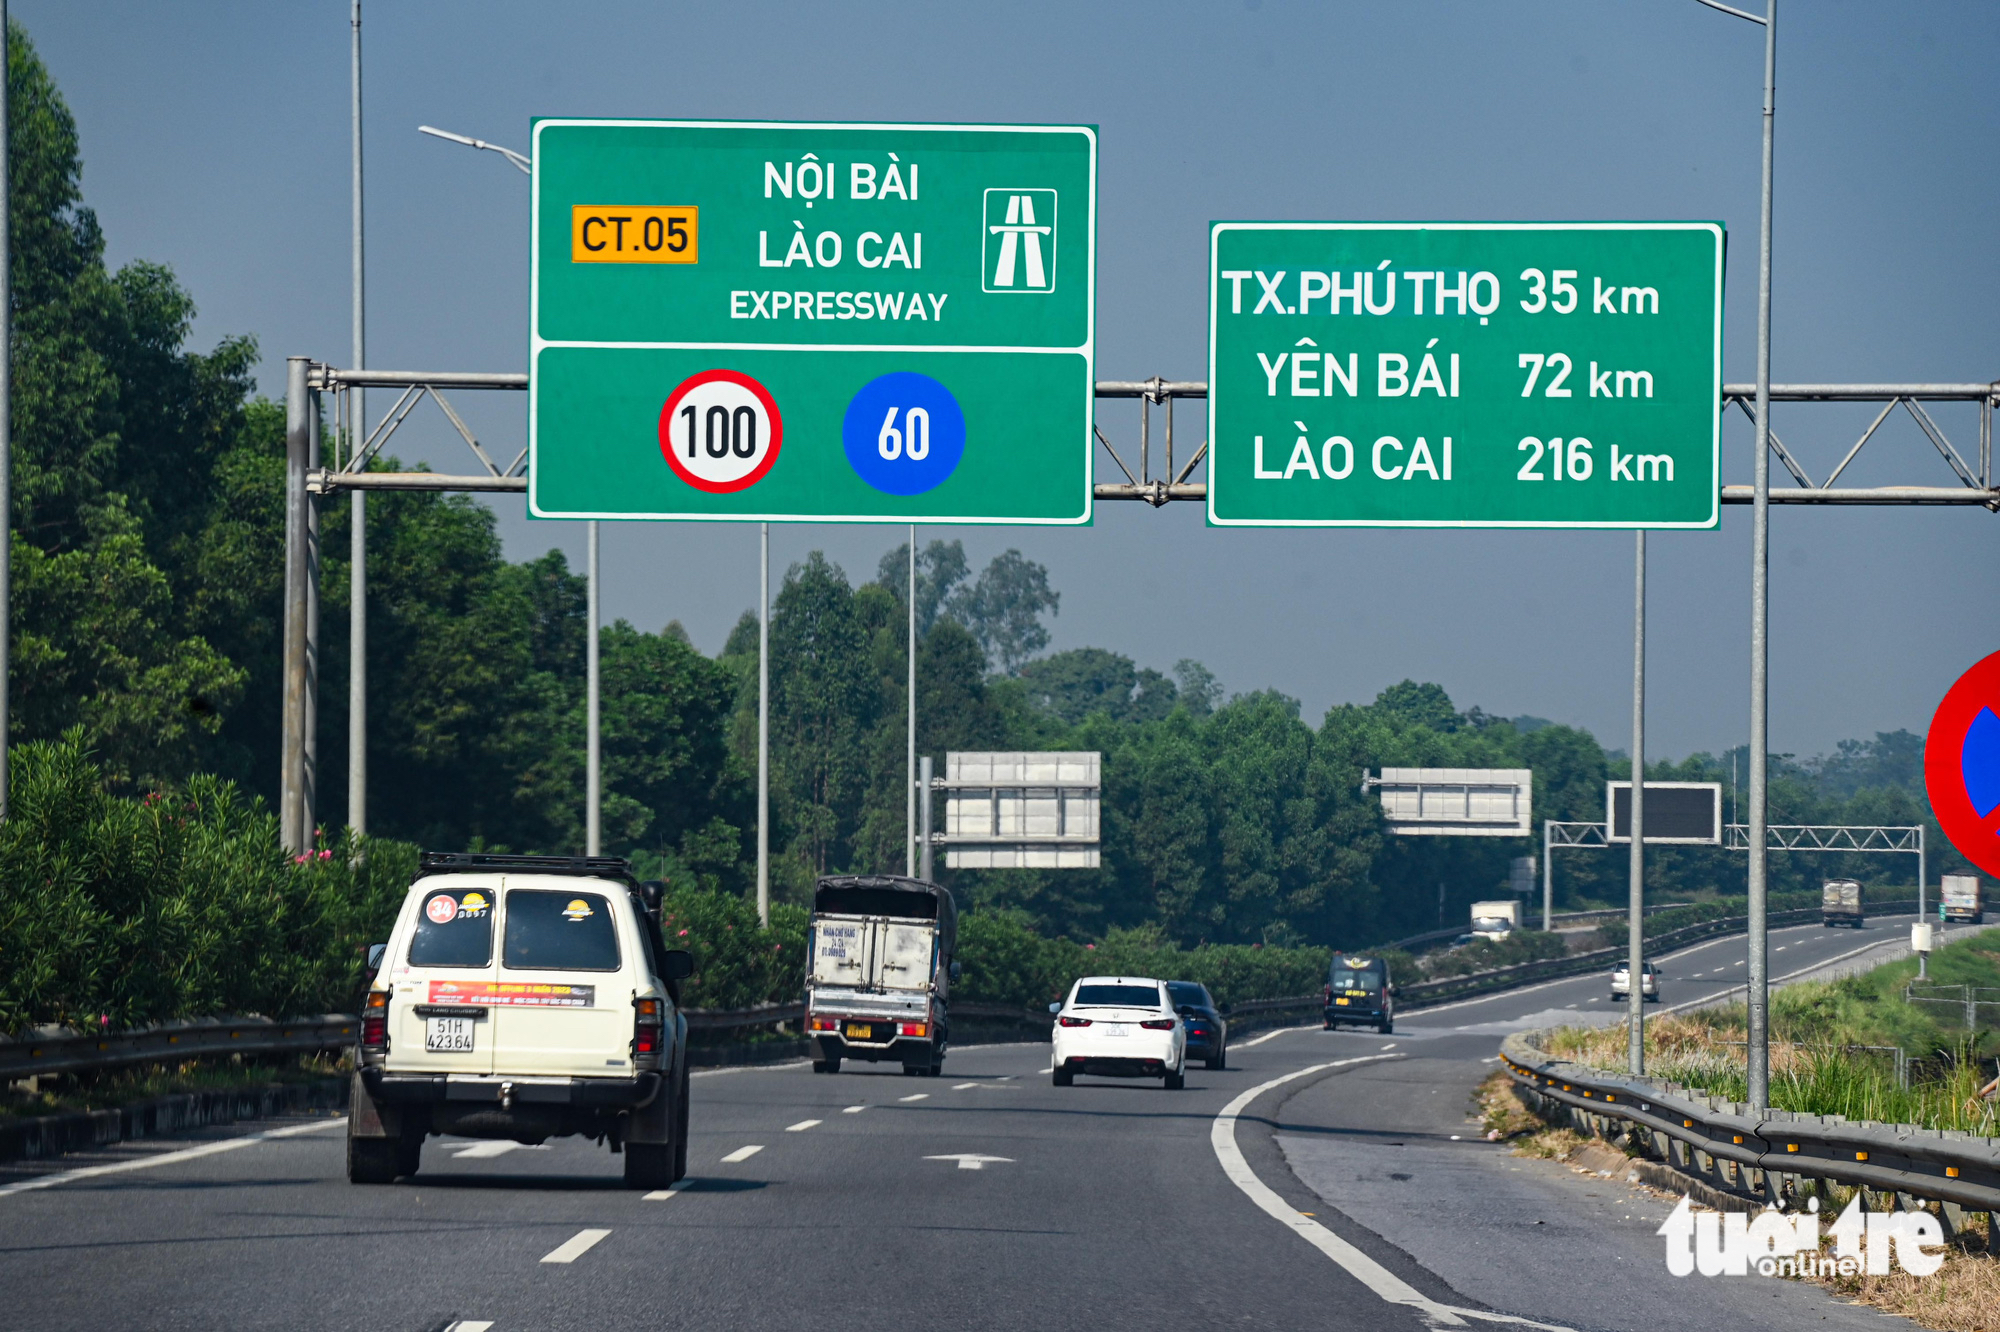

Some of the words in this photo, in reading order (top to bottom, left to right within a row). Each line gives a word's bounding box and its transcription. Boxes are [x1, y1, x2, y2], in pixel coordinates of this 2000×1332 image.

[764, 152, 835, 209] NỘI
[850, 152, 918, 201] BÀI
[582, 216, 688, 253] CT.05
[759, 220, 843, 268] LÀO
[856, 231, 922, 269] CAI
[730, 290, 948, 322] EXPRESSWAY
[1403, 271, 1500, 326] THỌ
[1519, 268, 1578, 314] 35
[1593, 276, 1659, 314] km
[1256, 337, 1358, 397] YÊN
[1377, 337, 1460, 398] BÁI
[1518, 352, 1573, 398] 72
[1589, 361, 1654, 398] km
[680, 405, 756, 459] 100
[877, 406, 930, 461] 60
[1253, 420, 1354, 480] LÀO
[1371, 436, 1452, 481] CAI
[1517, 436, 1593, 481] 216
[1610, 444, 1674, 482] km
[431, 900, 453, 918] 34
[427, 1034, 471, 1050] 423.64
[437, 1018, 463, 1034] 51H
